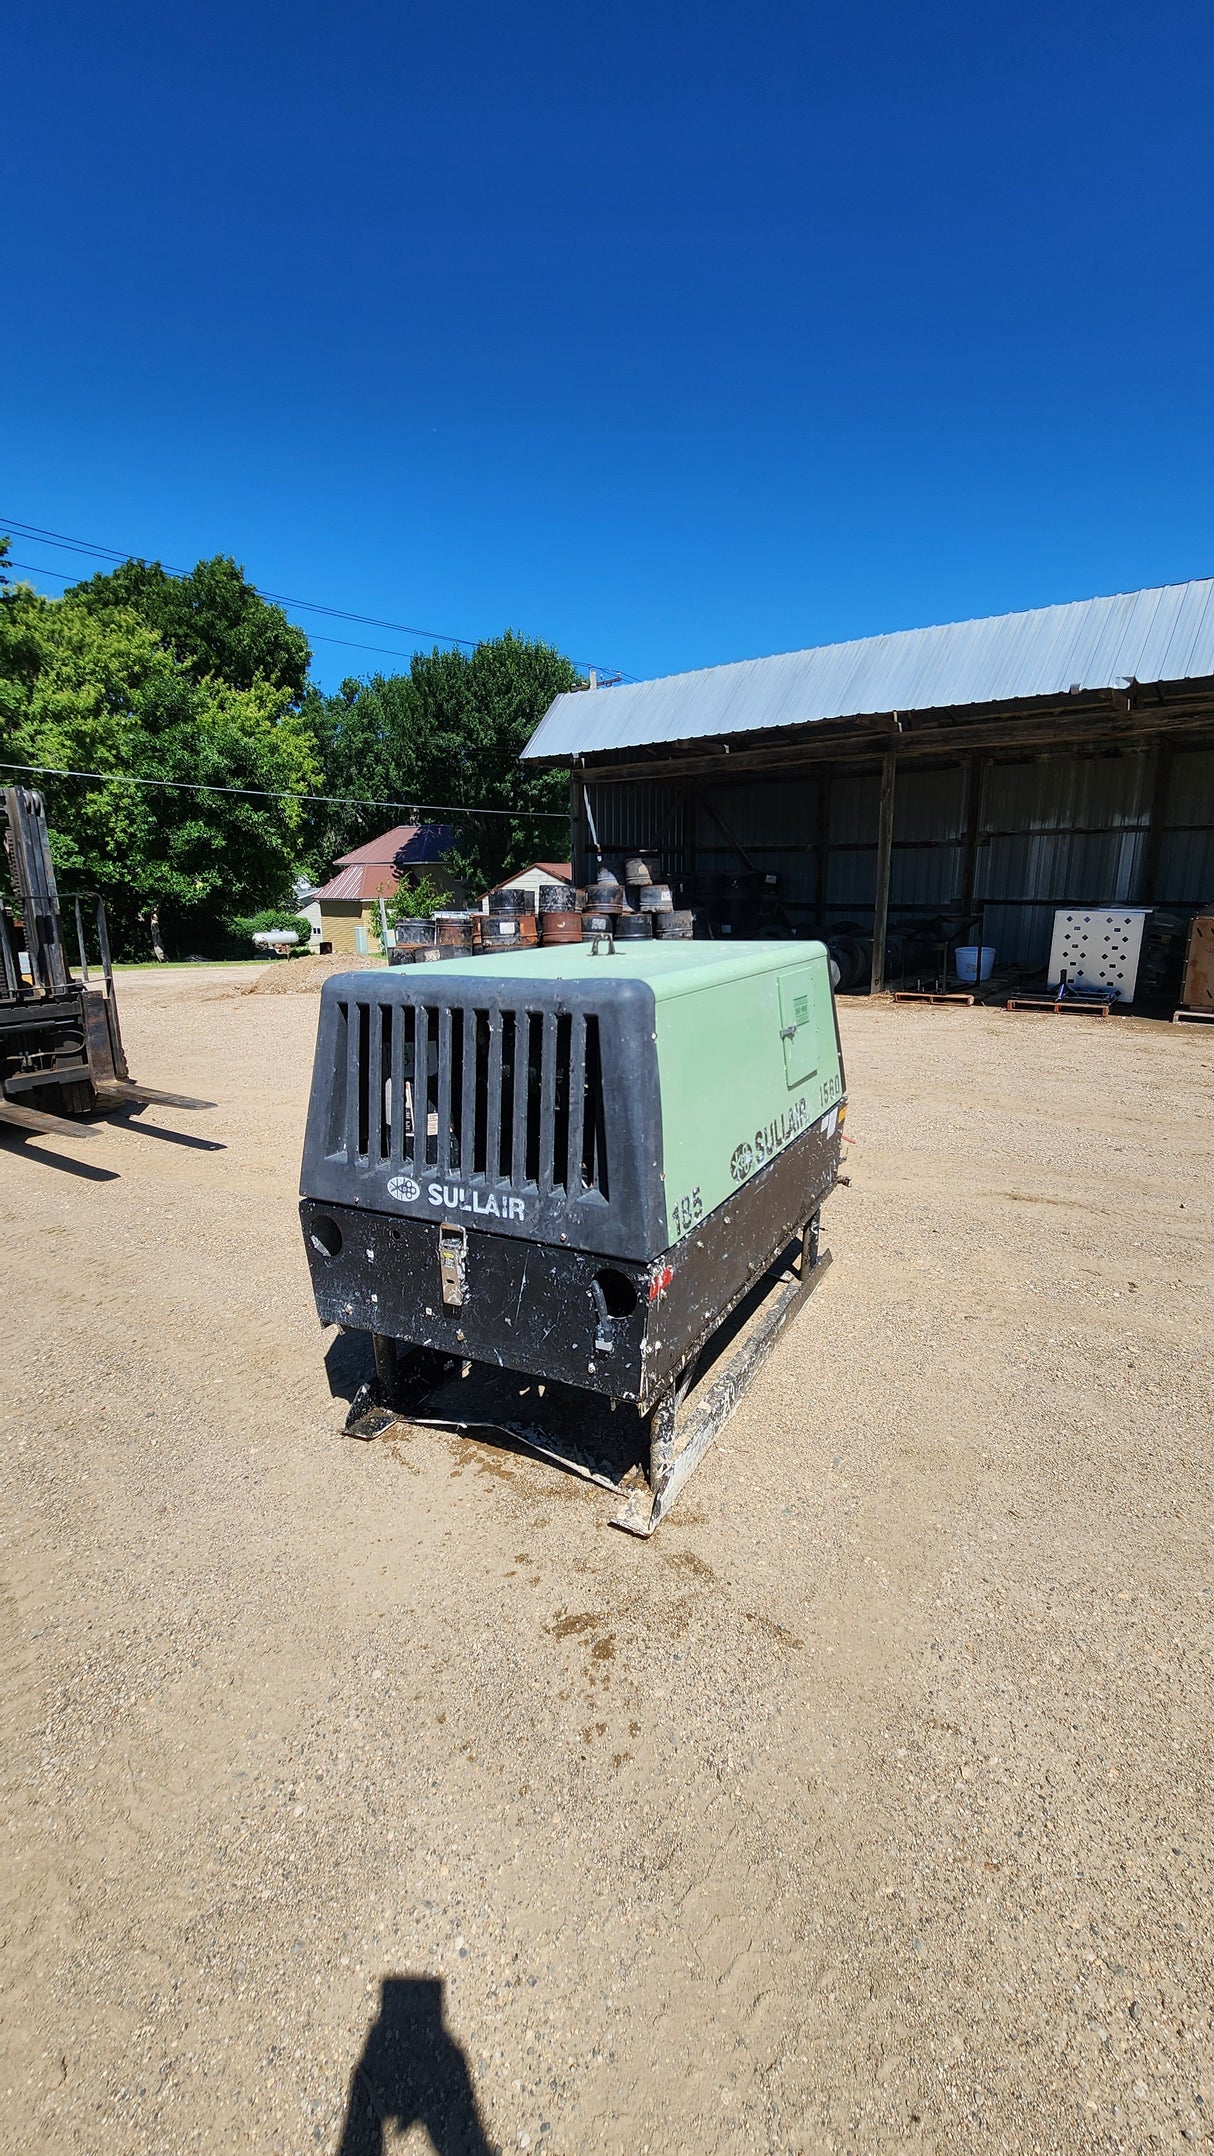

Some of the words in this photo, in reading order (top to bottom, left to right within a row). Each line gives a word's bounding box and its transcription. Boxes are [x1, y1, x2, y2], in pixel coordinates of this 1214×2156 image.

[427, 1183, 525, 1221] SULLAIR
[672, 1186, 703, 1236] 185
[755, 1097, 809, 1164] SULLAIR
